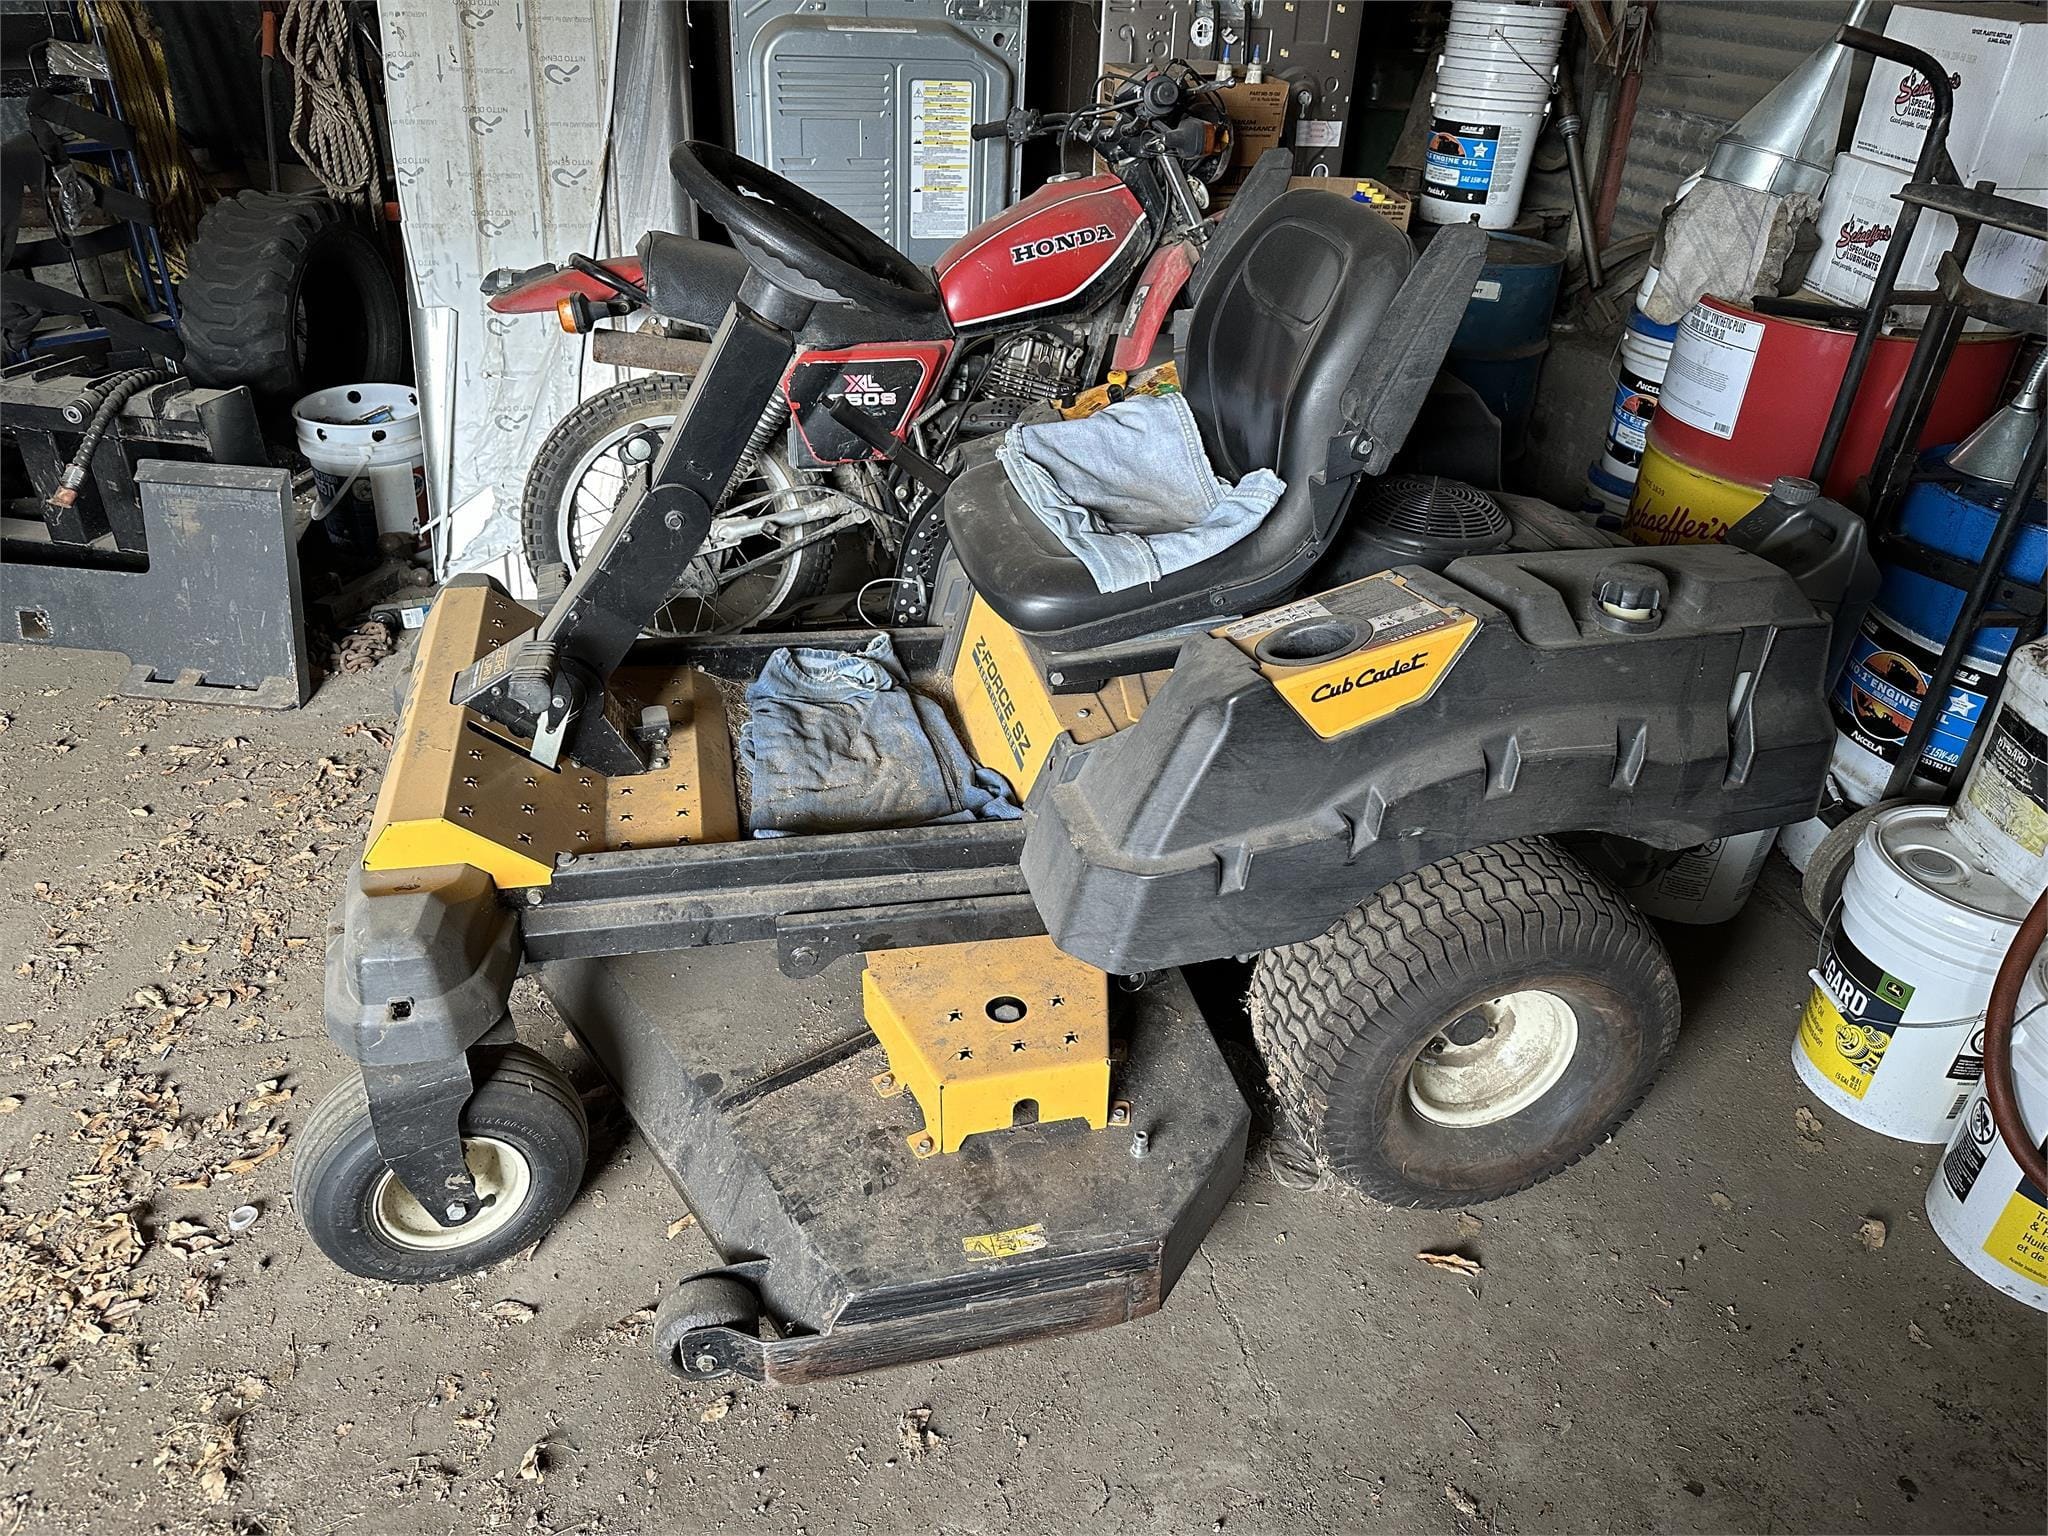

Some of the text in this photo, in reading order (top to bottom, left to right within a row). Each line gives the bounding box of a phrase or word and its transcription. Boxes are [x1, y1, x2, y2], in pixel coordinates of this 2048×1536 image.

[1907, 107, 1934, 120] LUBRICA
[1910, 98, 1936, 111] SPECIAL
[1432, 153, 1460, 165] ENGINE
[1462, 159, 1478, 167] OIL
[1010, 225, 1116, 264] HONDA
[1849, 243, 1882, 263] SPECIALIZED
[1846, 252, 1879, 272] LUBRICANTS
[1733, 321, 1747, 335] PLUS
[843, 374, 884, 393] XL
[1636, 380, 1661, 395] AKCEL
[481, 652, 494, 682] TURN
[493, 647, 507, 675] ZERO
[1311, 652, 1429, 703] Cub Cadet
[975, 635, 1032, 756] Z-FORCE SZ
[1870, 678, 1920, 712] ENGINE
[1850, 730, 1884, 756] AKCELA
[1930, 746, 1959, 765] 15W-40
[2029, 1221, 2040, 1232] &
[2016, 1243, 2045, 1263] et de
